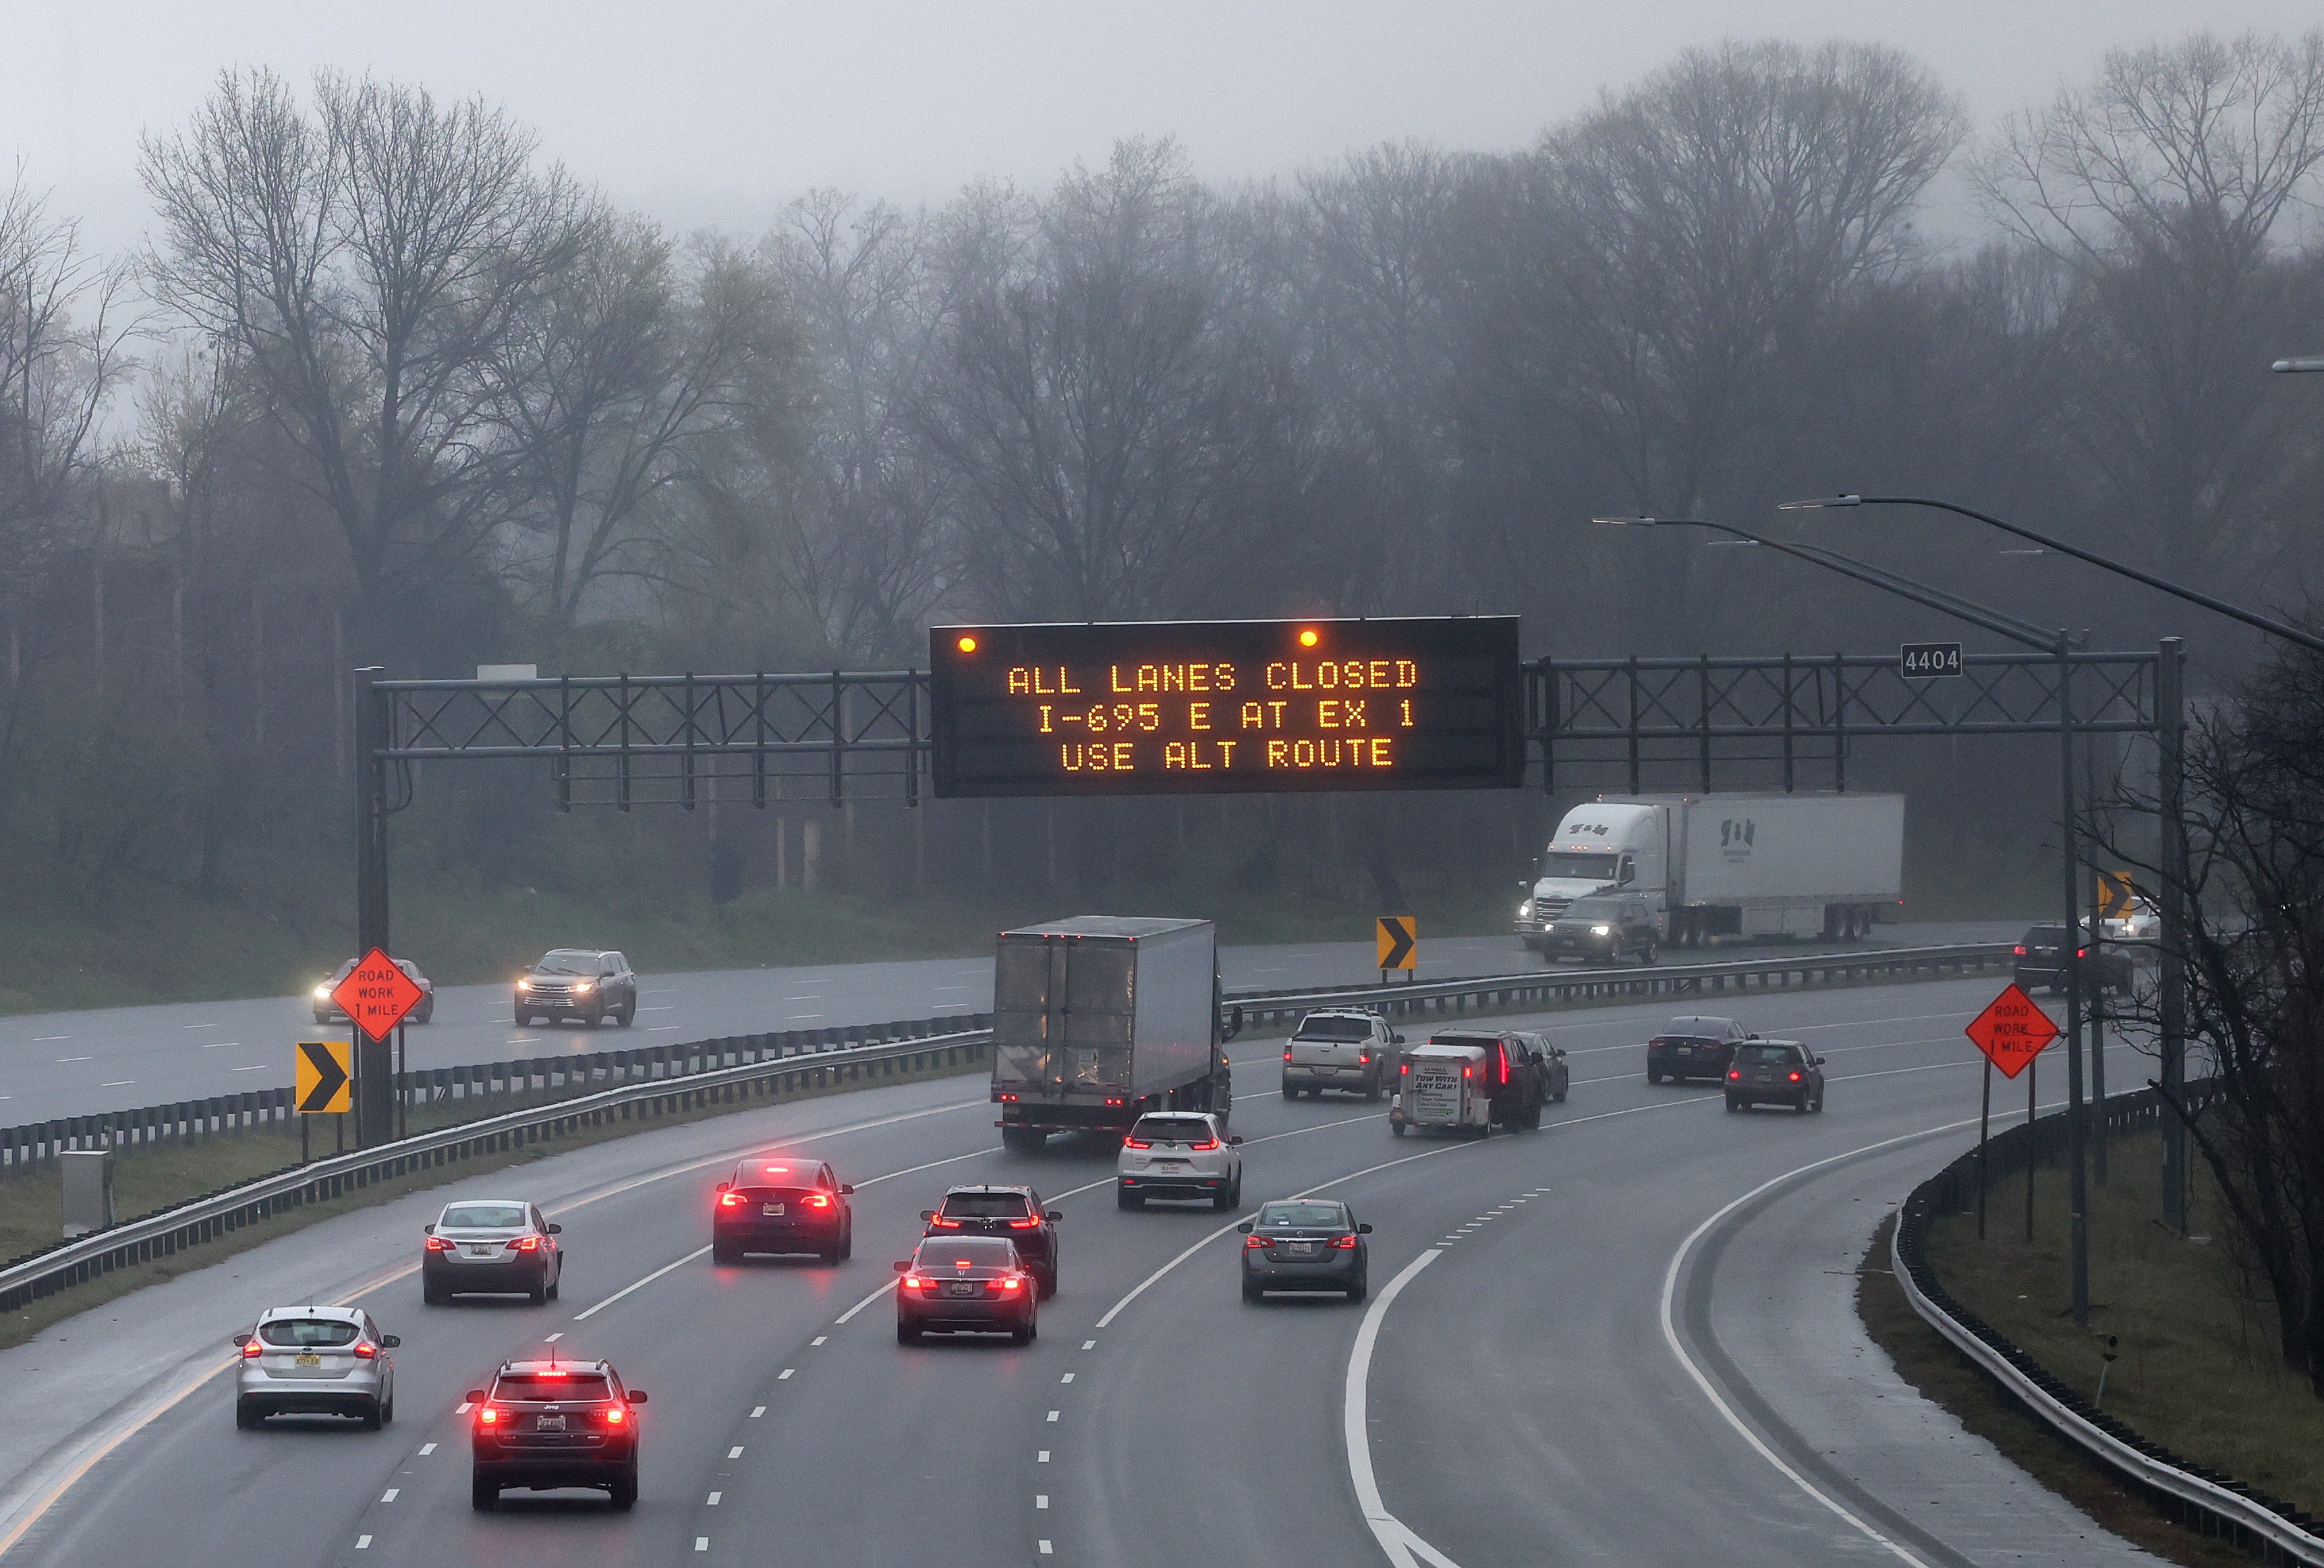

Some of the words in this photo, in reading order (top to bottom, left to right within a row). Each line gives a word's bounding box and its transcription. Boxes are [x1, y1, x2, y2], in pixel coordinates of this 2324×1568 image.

[1906, 650, 1958, 670] 4404
[1008, 666, 1081, 695] ALL
[1110, 662, 1236, 693] LANES
[1266, 660, 1417, 691] CLOSED
[1038, 703, 1160, 733] I-695
[1190, 701, 1212, 730] E
[1241, 700, 1288, 730] AT
[1318, 699, 1366, 729] EX
[1400, 699, 1414, 727] 1
[1062, 742, 1135, 772] USE
[1164, 741, 1237, 770] ALT
[1267, 738, 1393, 768] ROUTE
[359, 970, 394, 981] ROAD
[359, 987, 395, 999] WORK
[356, 1003, 360, 1019] 1
[368, 1004, 399, 1016] MILE
[1995, 1006, 2029, 1017] ROAD
[1993, 1022, 2029, 1035] WORK
[1990, 1039, 1995, 1055] 1
[2002, 1041, 2033, 1052] MILE
[1415, 1074, 1434, 1082] TOW
[1435, 1075, 1458, 1083] WITH
[1435, 1082, 1456, 1091] CAR!
